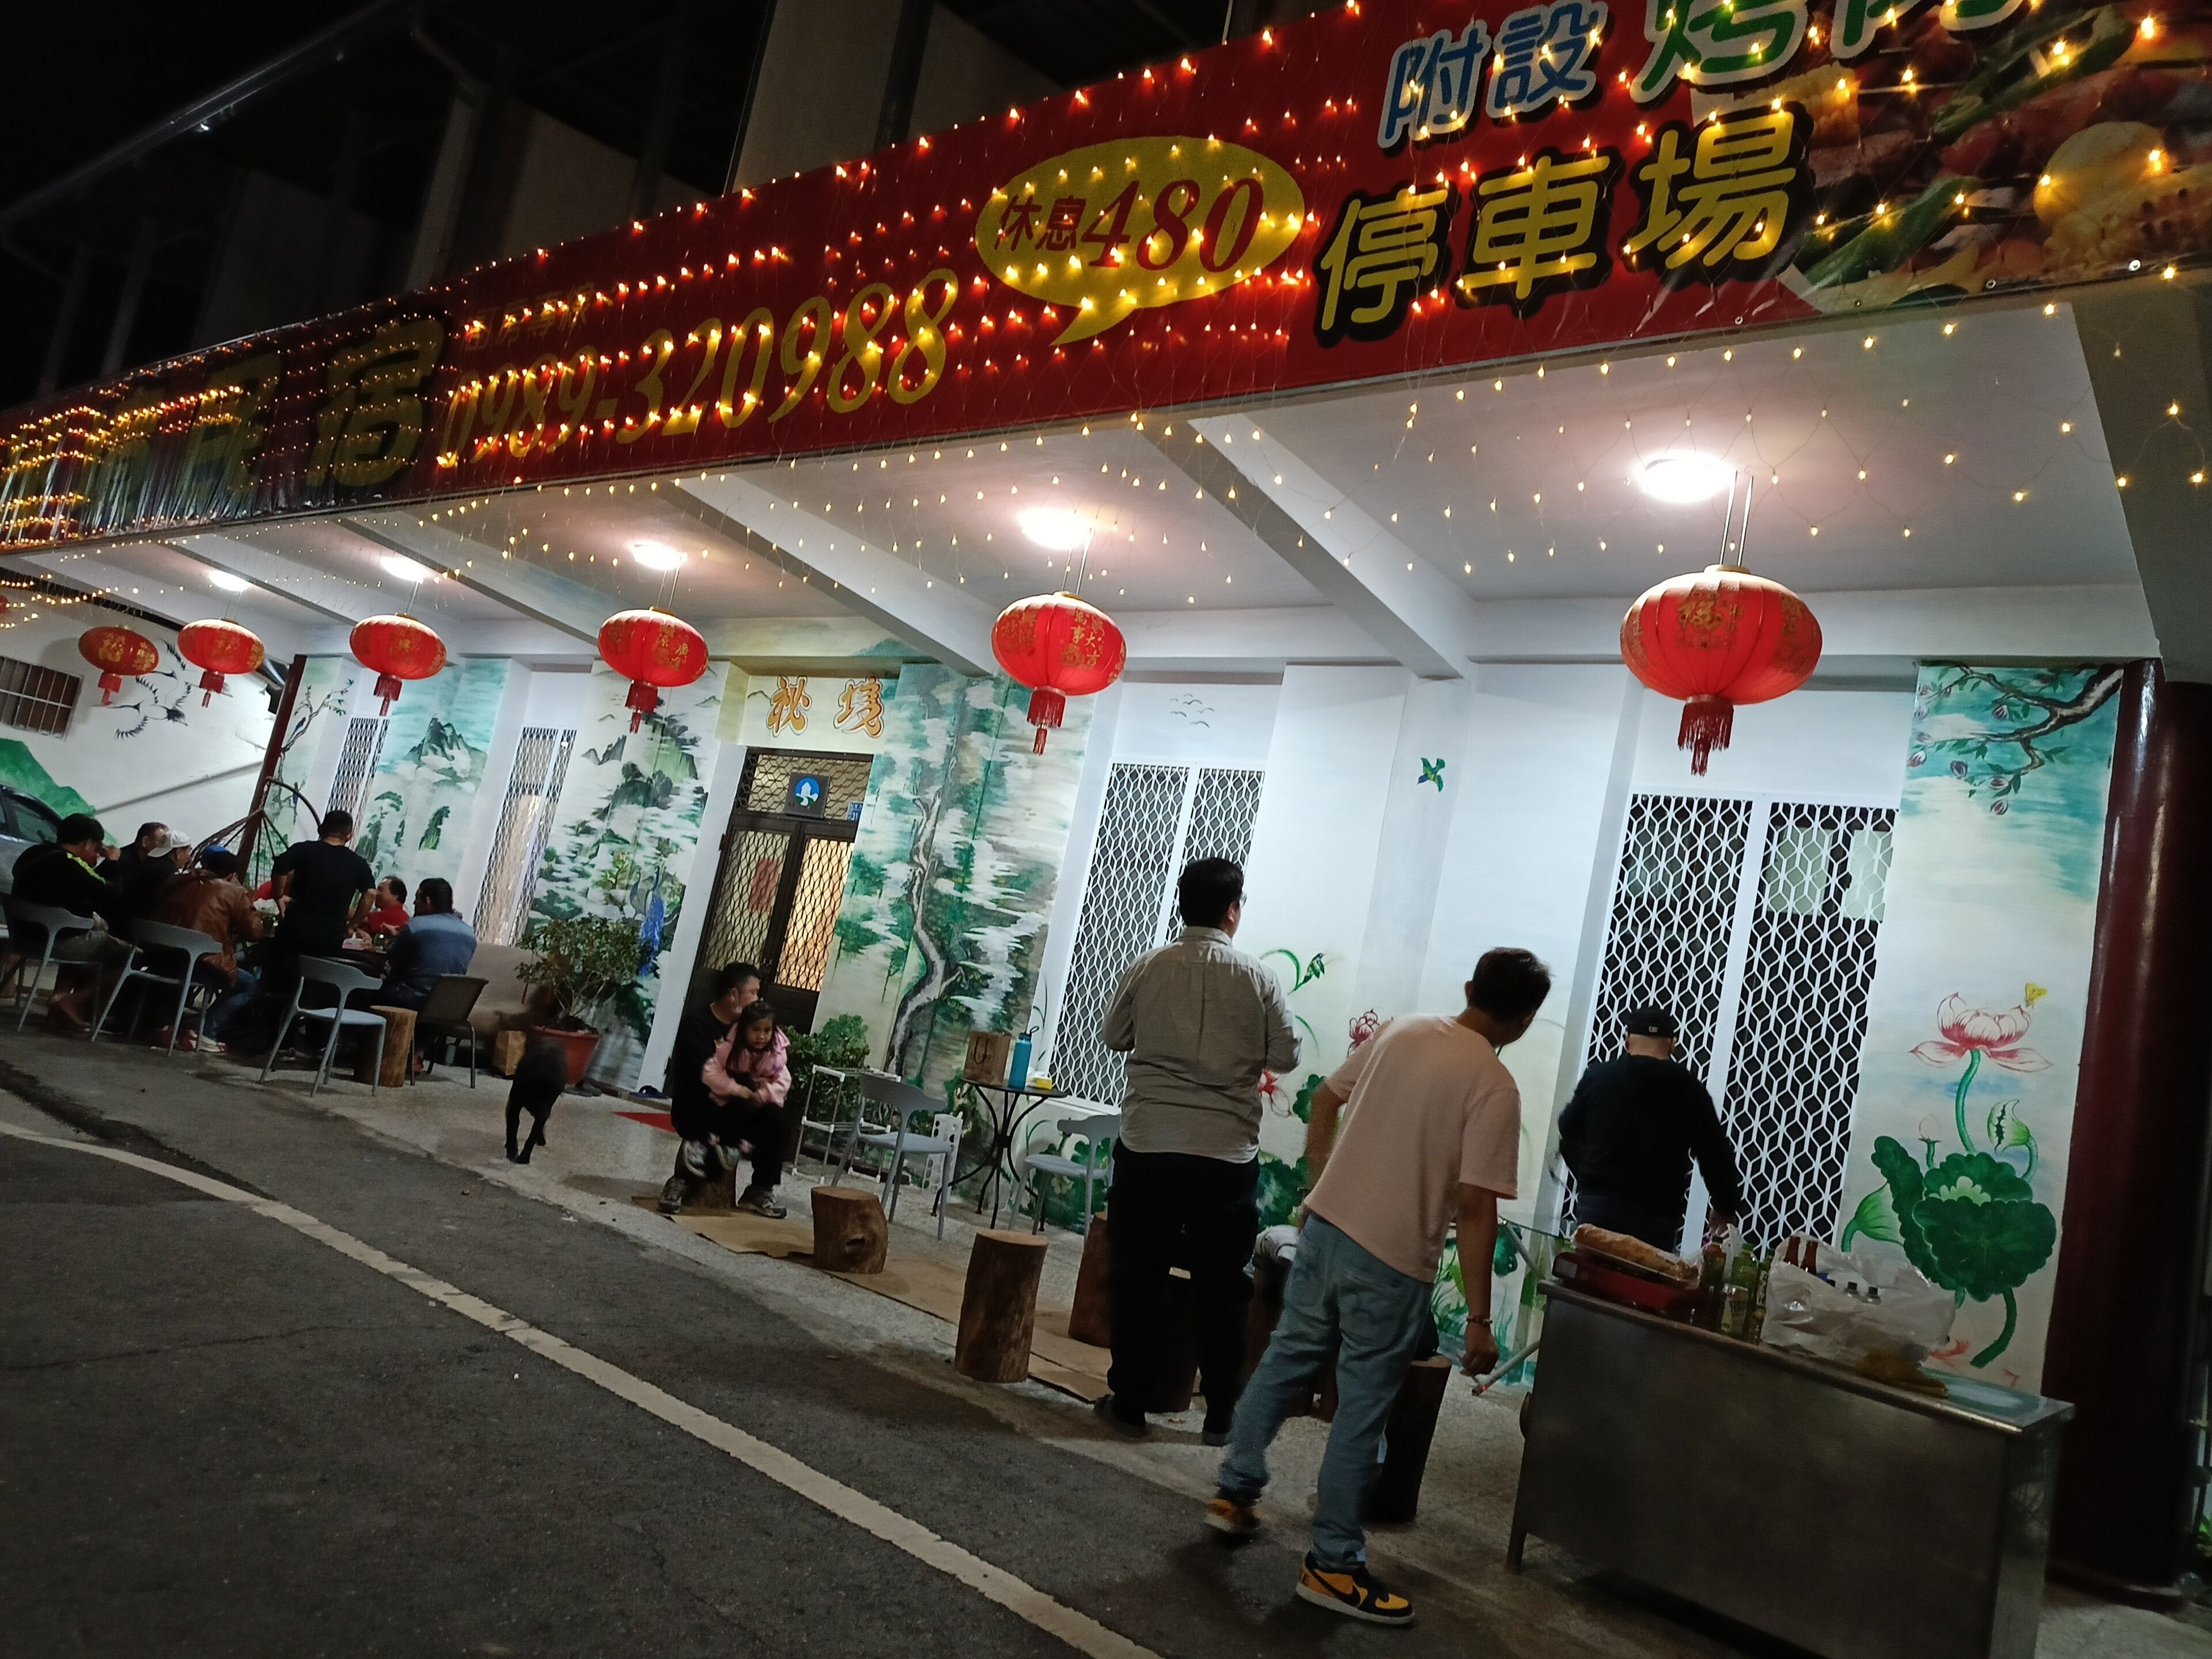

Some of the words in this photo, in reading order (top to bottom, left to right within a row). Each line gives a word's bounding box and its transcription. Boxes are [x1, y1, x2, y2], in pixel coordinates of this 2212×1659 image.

[1377, 2, 1607, 149] 附設
[994, 195, 1087, 252] 休息
[1082, 177, 1263, 274] 480
[1319, 111, 1797, 332] 停車場
[436, 268, 959, 469] 0989-320988
